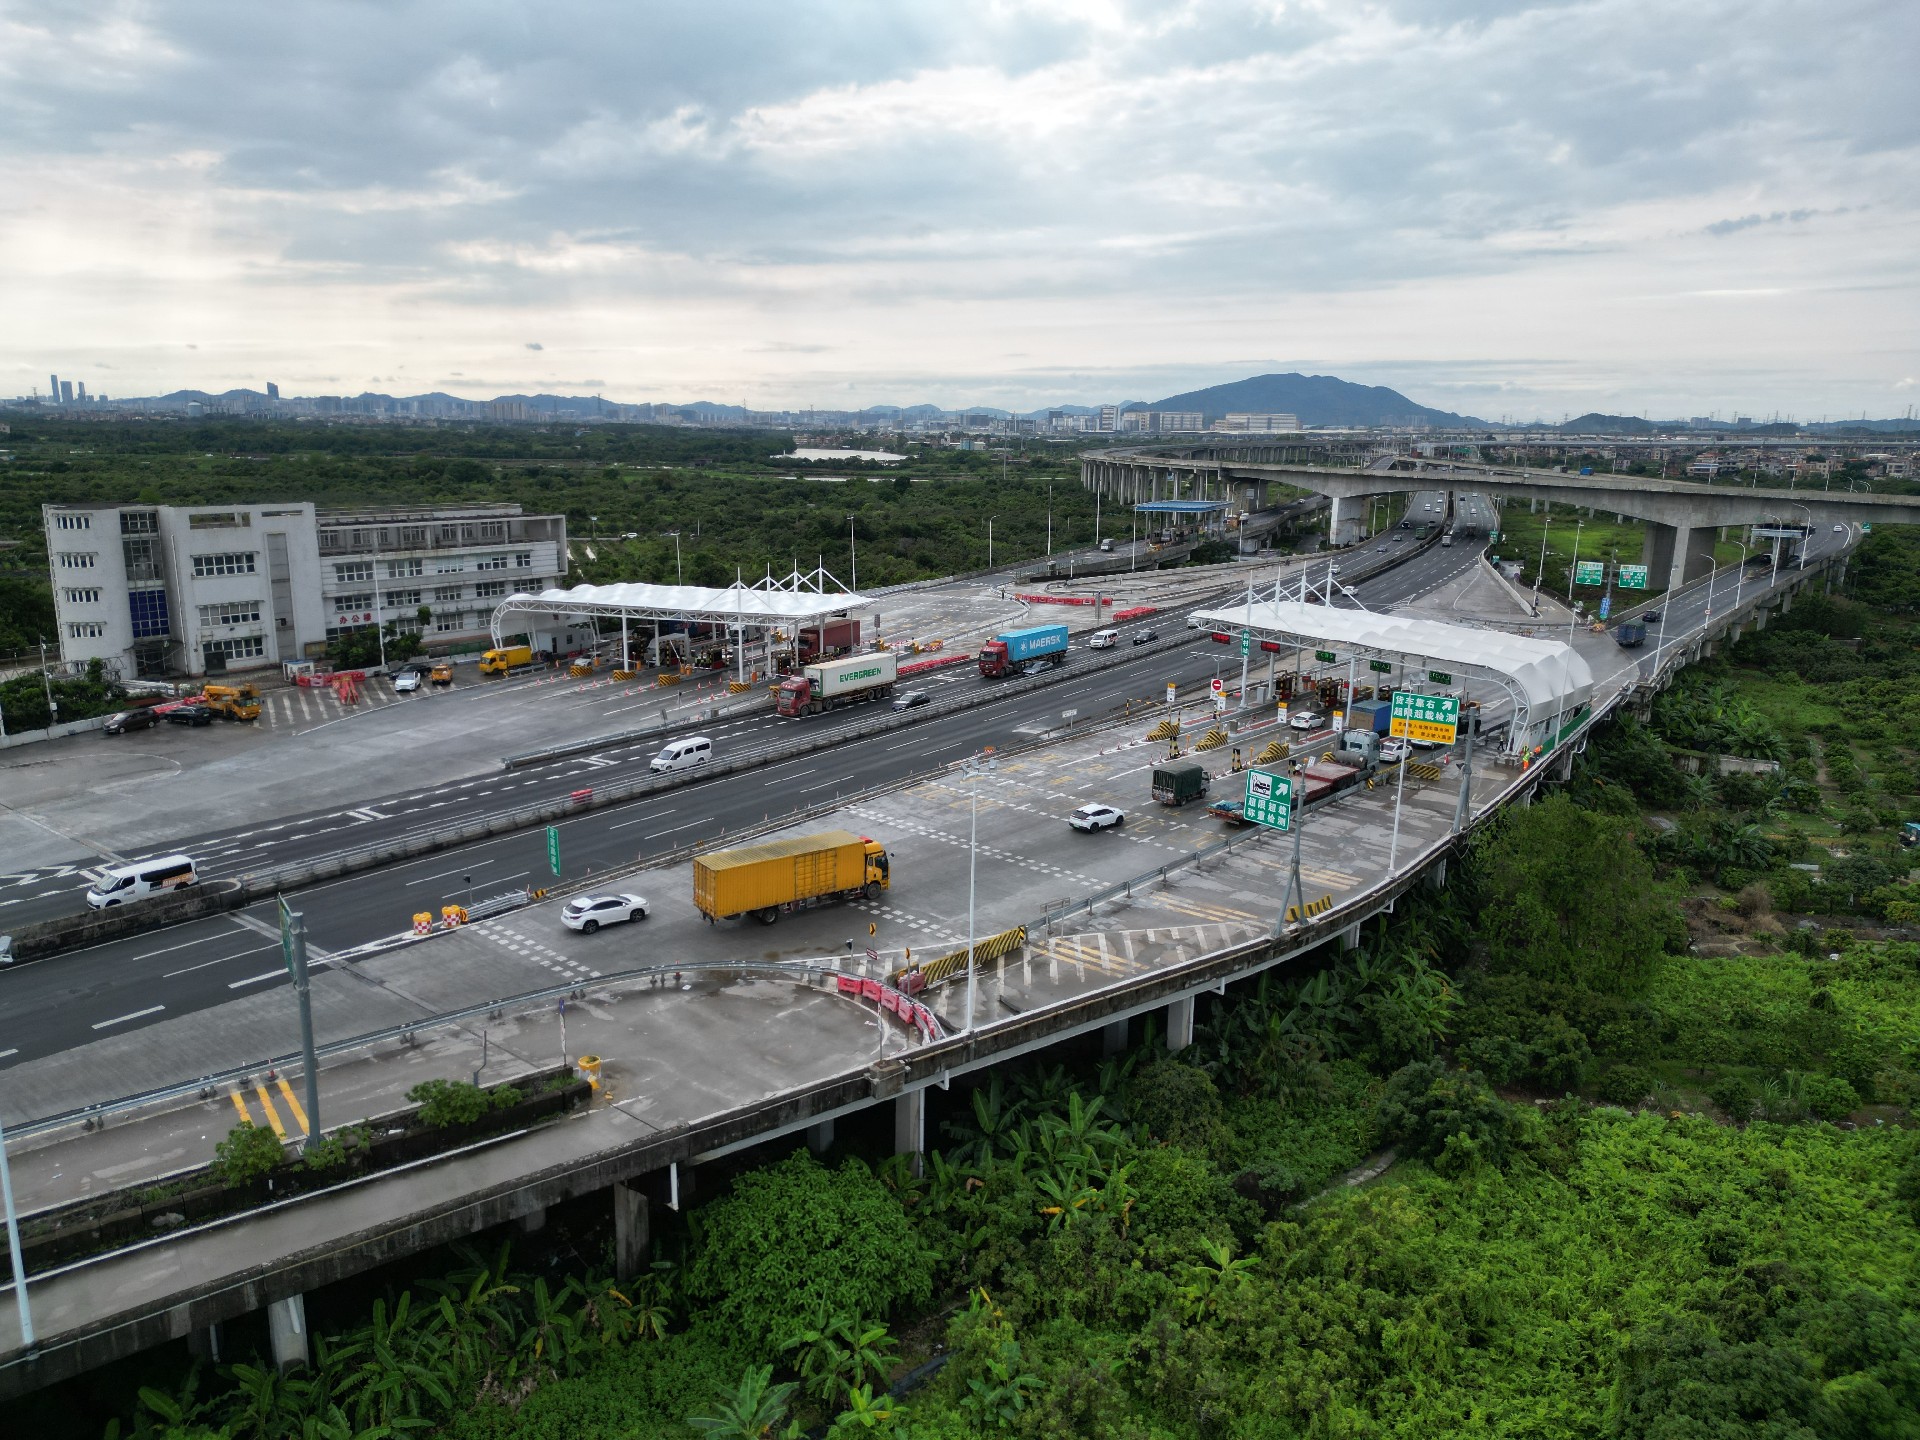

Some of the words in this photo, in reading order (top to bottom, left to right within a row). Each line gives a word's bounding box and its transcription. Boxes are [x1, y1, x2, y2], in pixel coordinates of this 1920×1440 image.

[339, 613, 372, 624] 办公楼
[1029, 635, 1061, 650] MAERSK
[840, 667, 881, 682] EVERGREEN
[1395, 695, 1435, 708] 货车靠右
[1393, 707, 1456, 723] 超限超载检测
[1247, 796, 1288, 816] 超限超载
[1246, 807, 1287, 827] 称重检测
